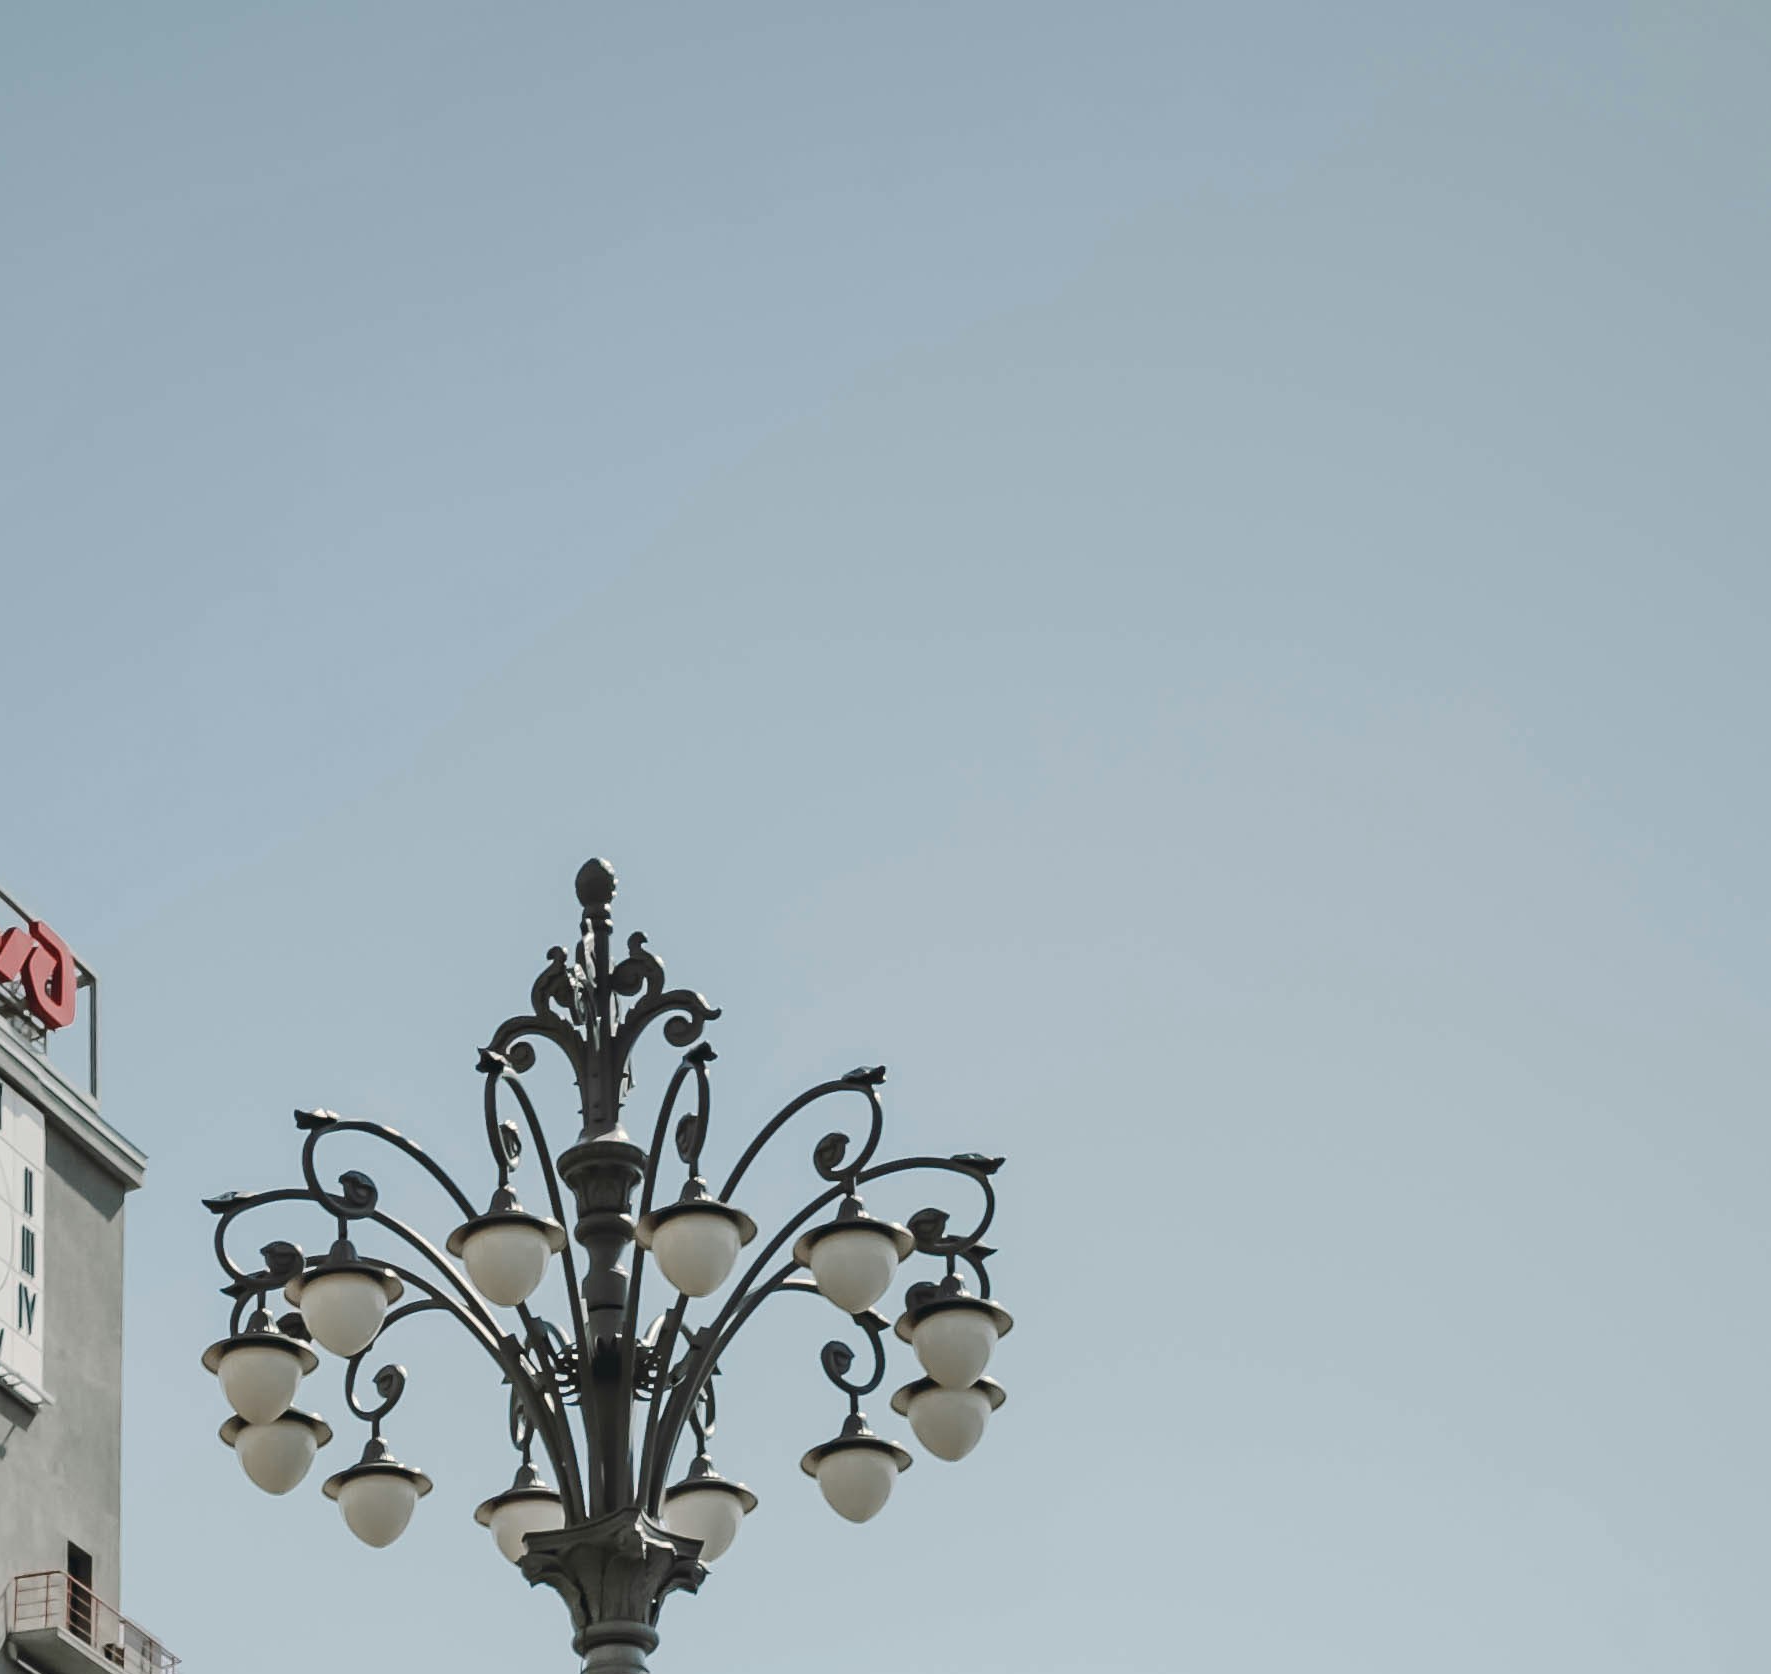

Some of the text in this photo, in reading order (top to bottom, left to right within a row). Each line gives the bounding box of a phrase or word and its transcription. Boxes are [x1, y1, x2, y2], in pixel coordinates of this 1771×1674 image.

[24, 1167, 33, 1218] II
[22, 1224, 35, 1278] III
[19, 1283, 36, 1335] IV
